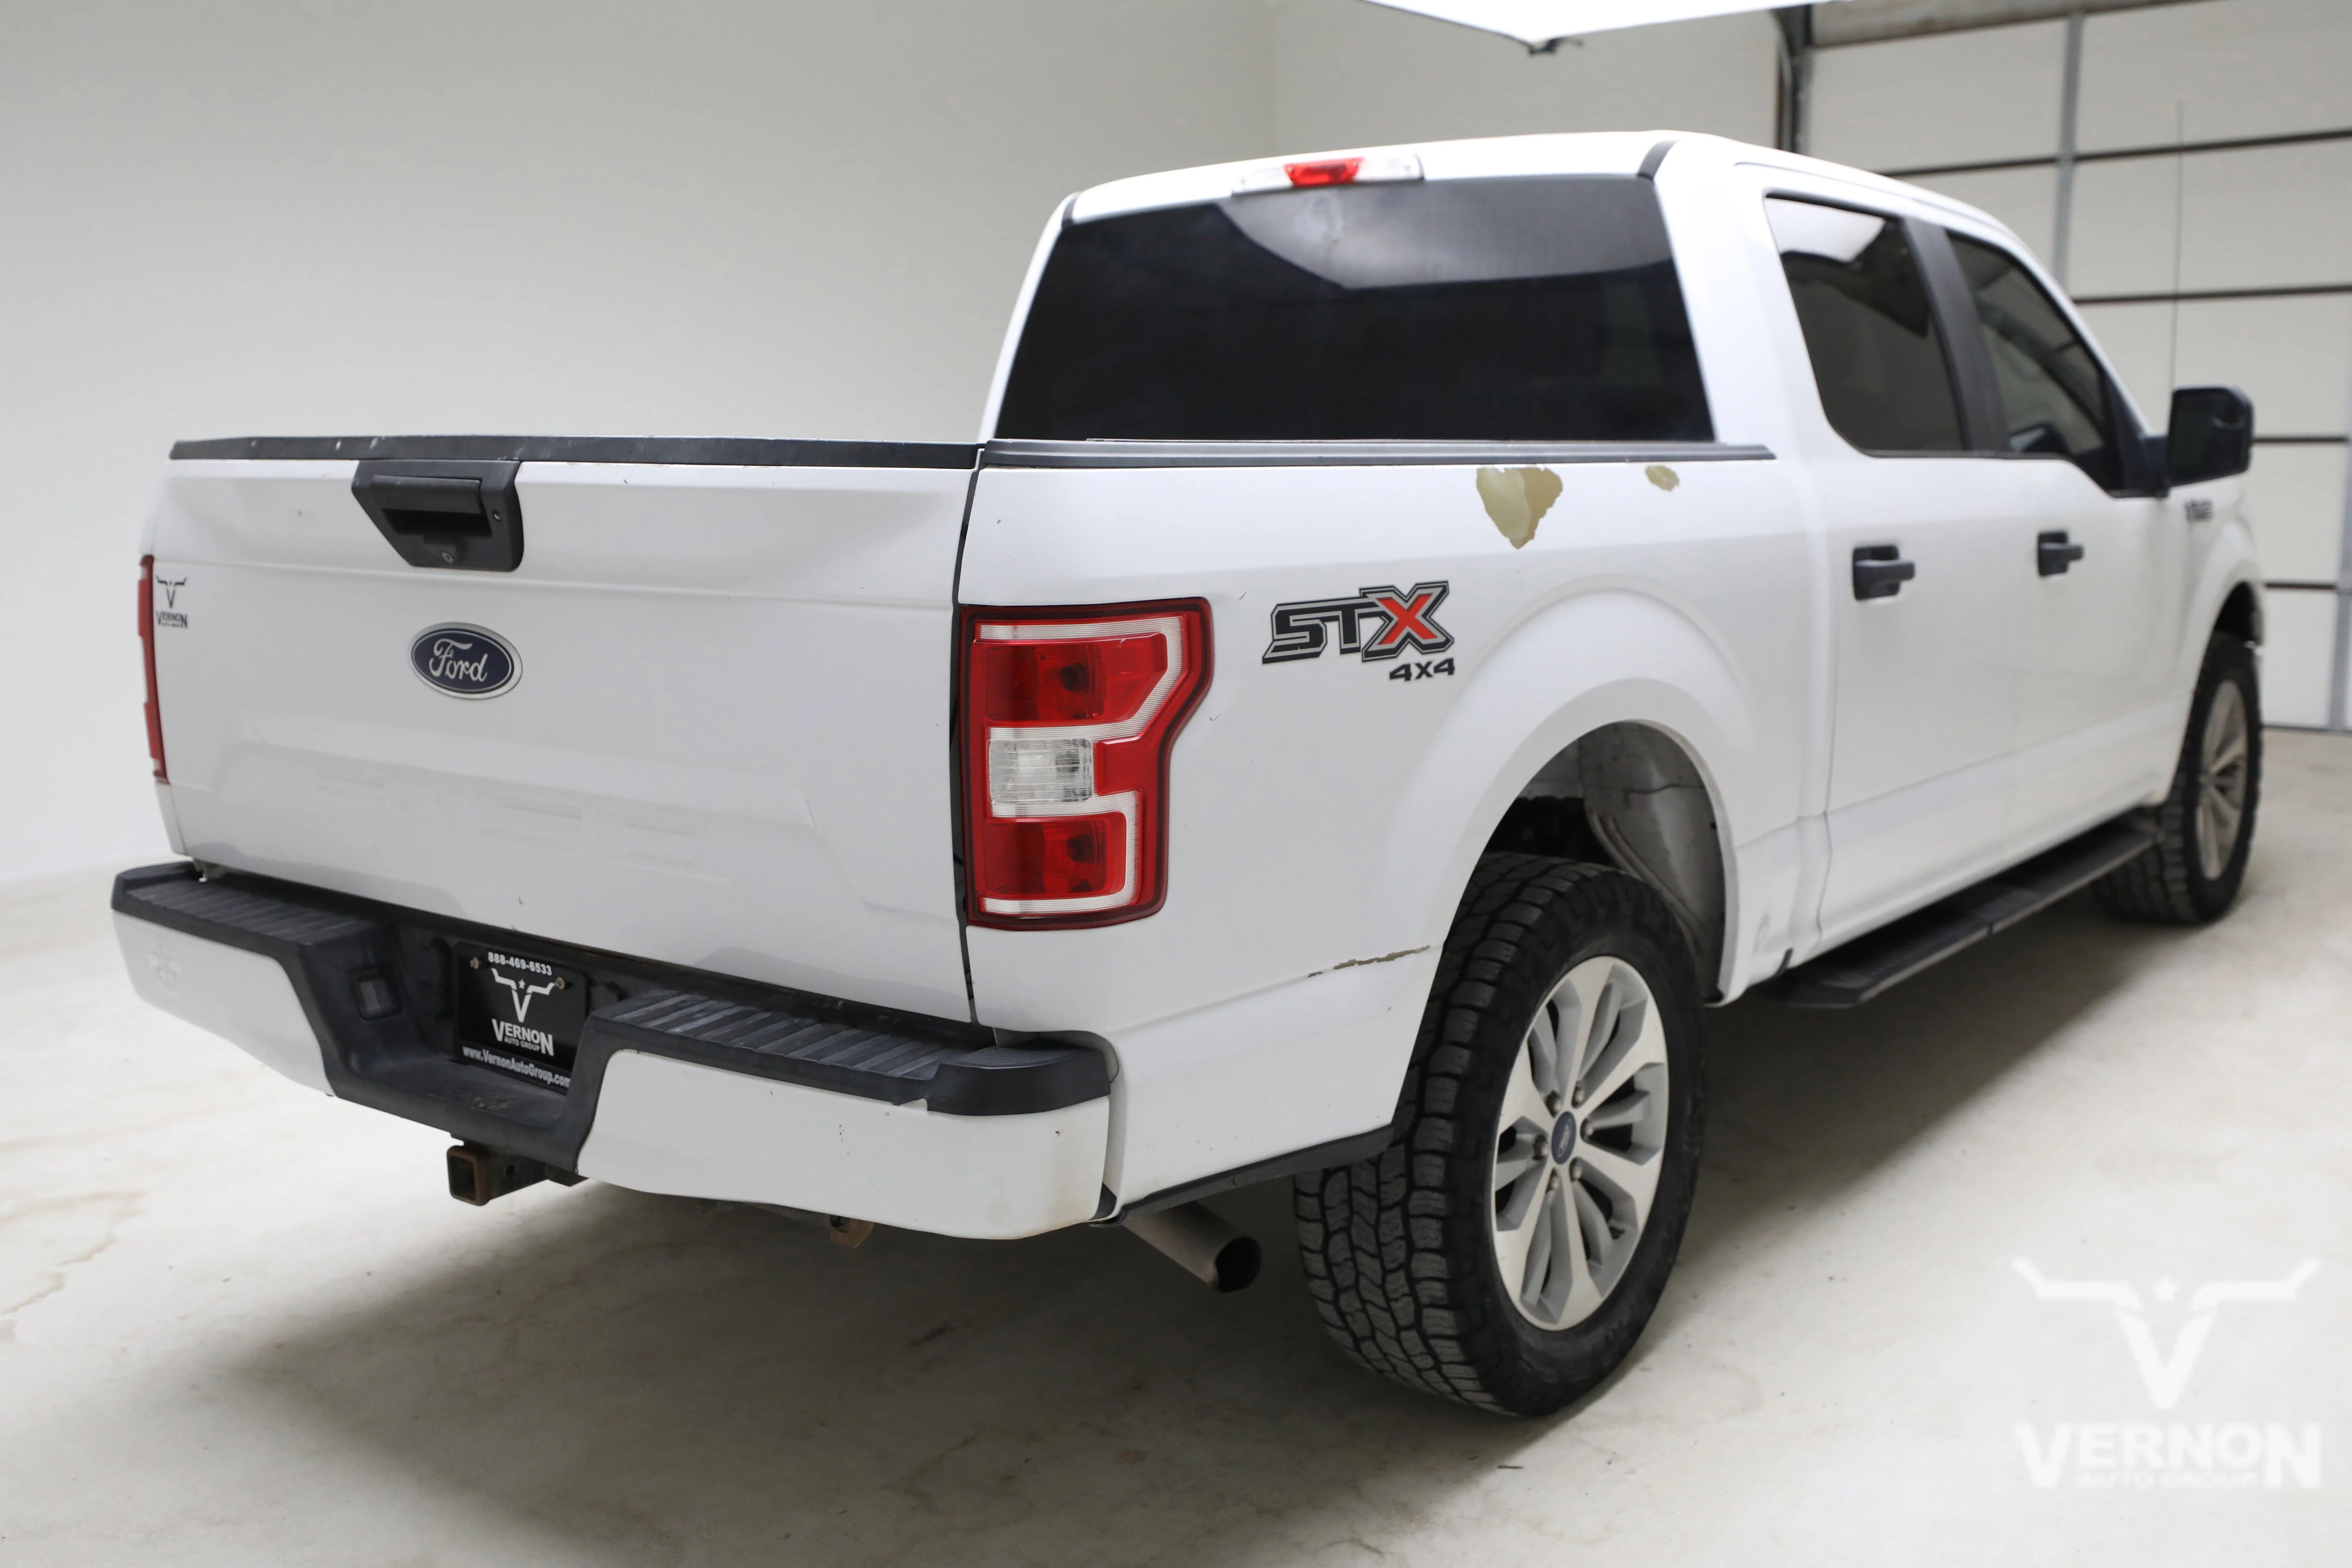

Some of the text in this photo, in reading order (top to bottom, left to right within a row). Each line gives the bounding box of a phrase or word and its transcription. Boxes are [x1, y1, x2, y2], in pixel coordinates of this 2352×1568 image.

[1263, 581, 1454, 664] STX
[429, 638, 488, 682] Ford
[488, 952, 552, 976] 888-469-6533
[492, 1018, 554, 1056] VERNON
[462, 1046, 570, 1087] www.VernonAutoGroup.com
